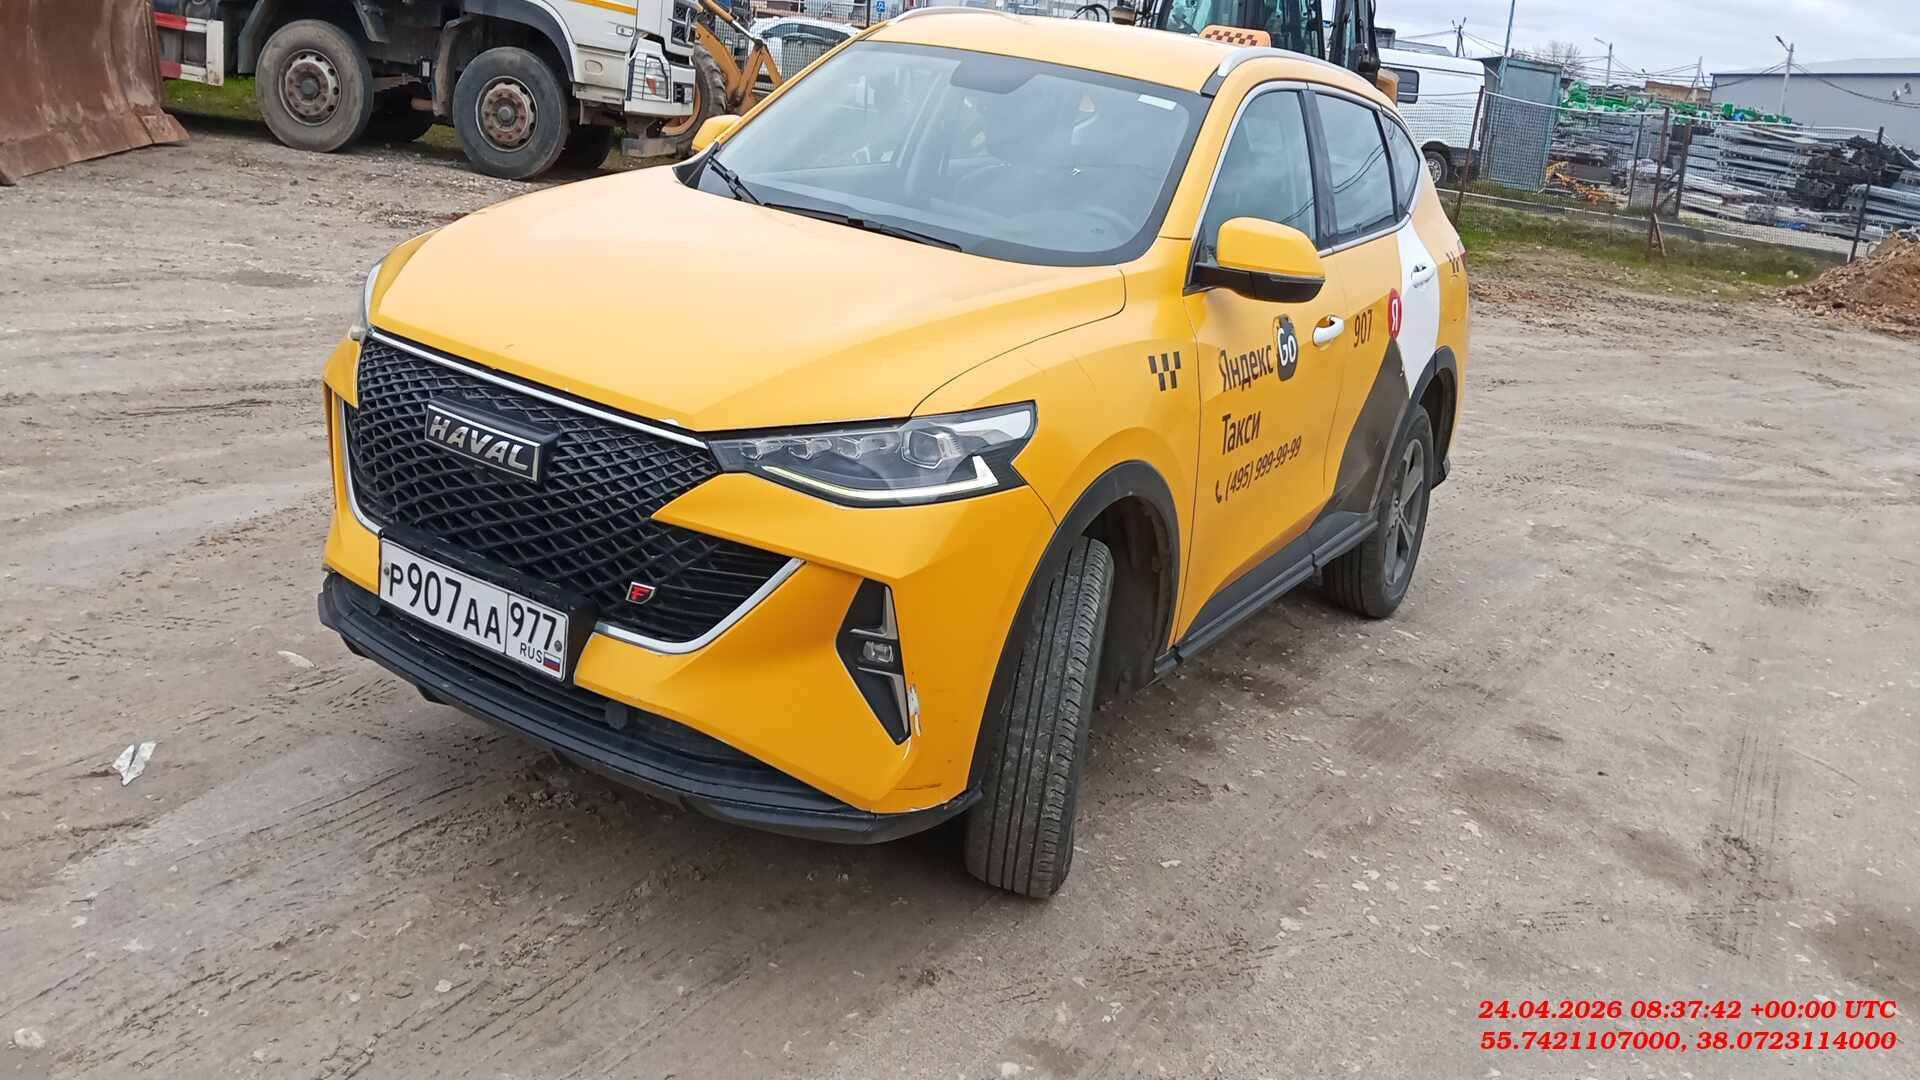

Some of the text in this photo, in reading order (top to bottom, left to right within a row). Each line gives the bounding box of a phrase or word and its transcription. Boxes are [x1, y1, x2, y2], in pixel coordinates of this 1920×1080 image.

[1354, 309, 1373, 348] 907
[1218, 328, 1297, 392] Яндекс Go
[429, 415, 529, 471] HAVAL
[1222, 411, 1261, 455] Такси
[1225, 435, 1302, 501] (495) 999-99-99
[510, 602, 557, 650] 977
[520, 642, 543, 664] RUS
